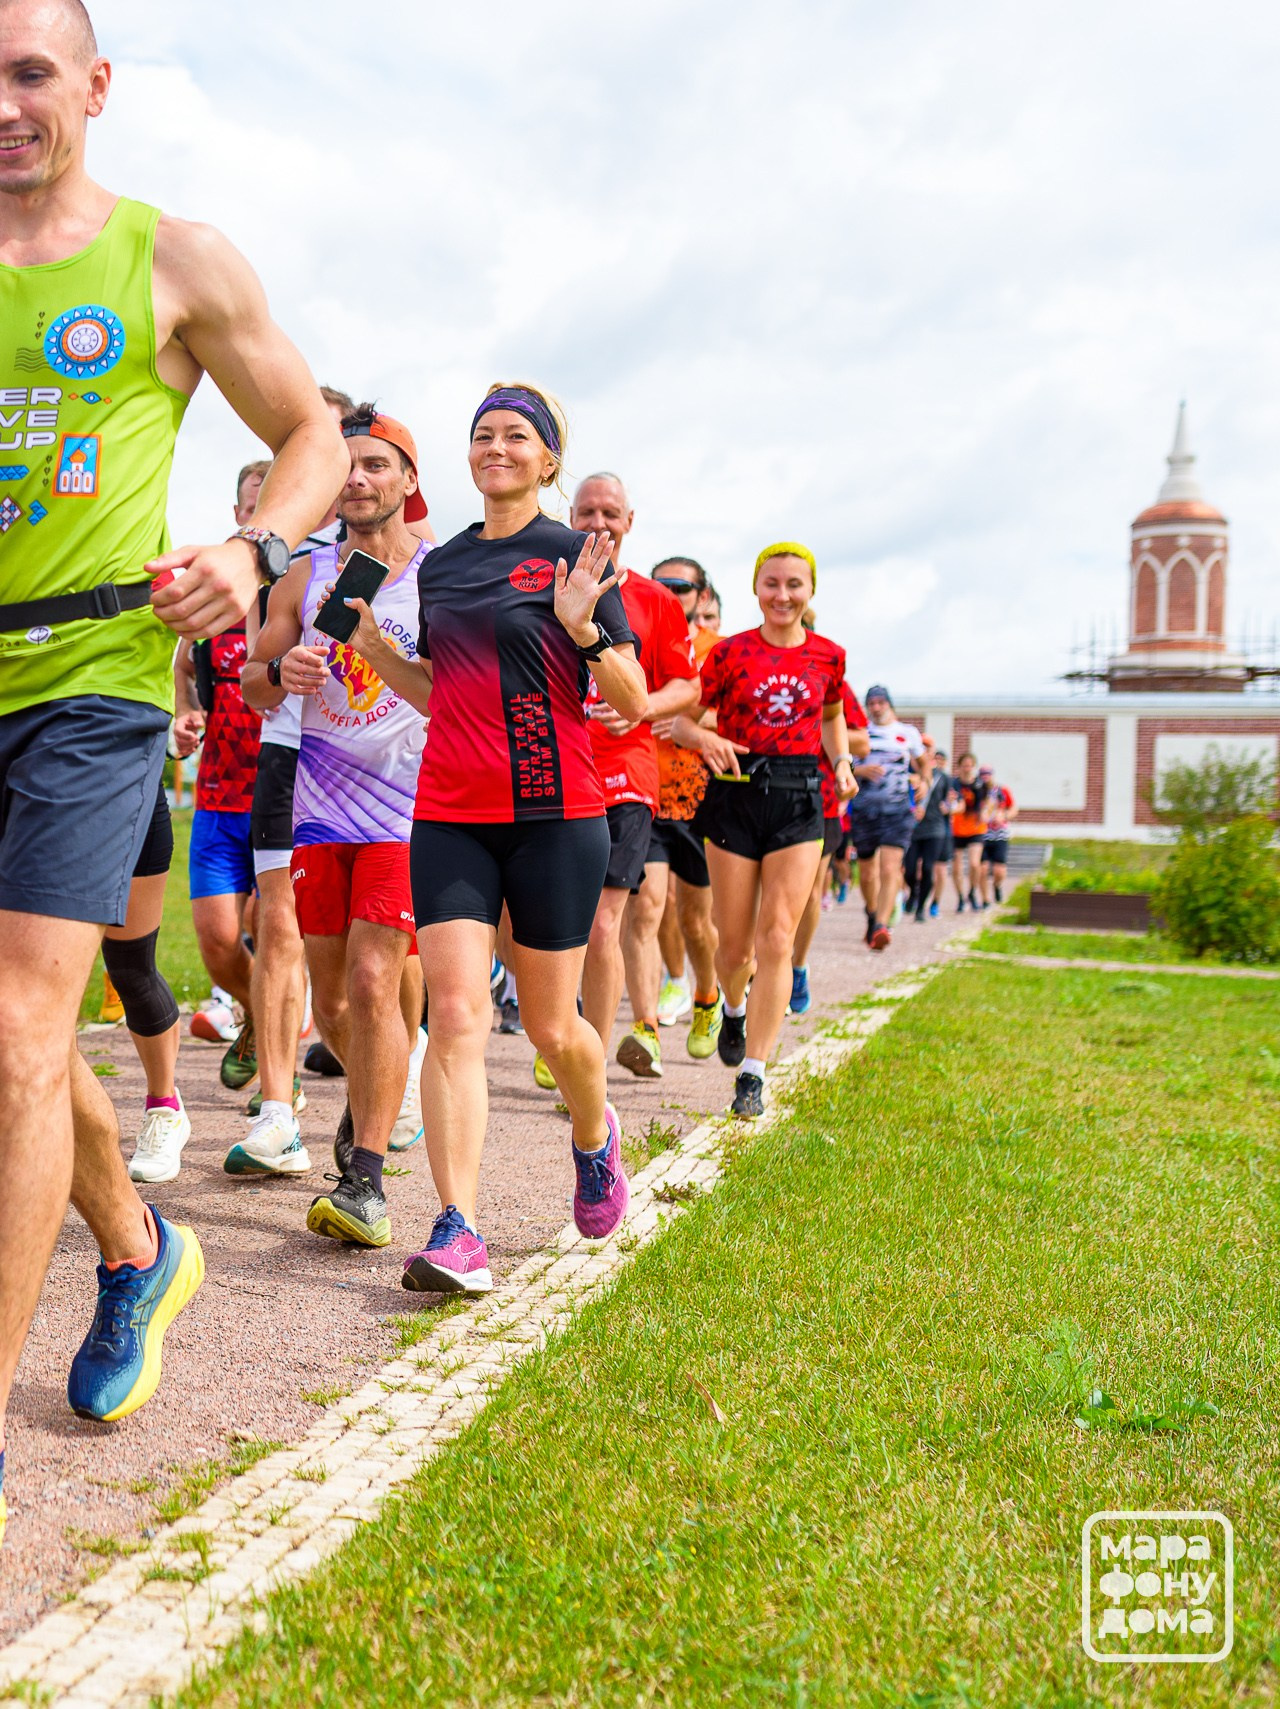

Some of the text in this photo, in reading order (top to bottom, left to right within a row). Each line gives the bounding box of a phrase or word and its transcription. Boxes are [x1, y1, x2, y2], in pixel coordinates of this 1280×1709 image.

[379, 618, 417, 660] ДОБРА
[753, 673, 812, 700] KLMNRUN
[510, 693, 533, 798] RUN TRAIL
[522, 693, 544, 797] ULTRATRAIL
[532, 692, 556, 797] SWIM BIKE
